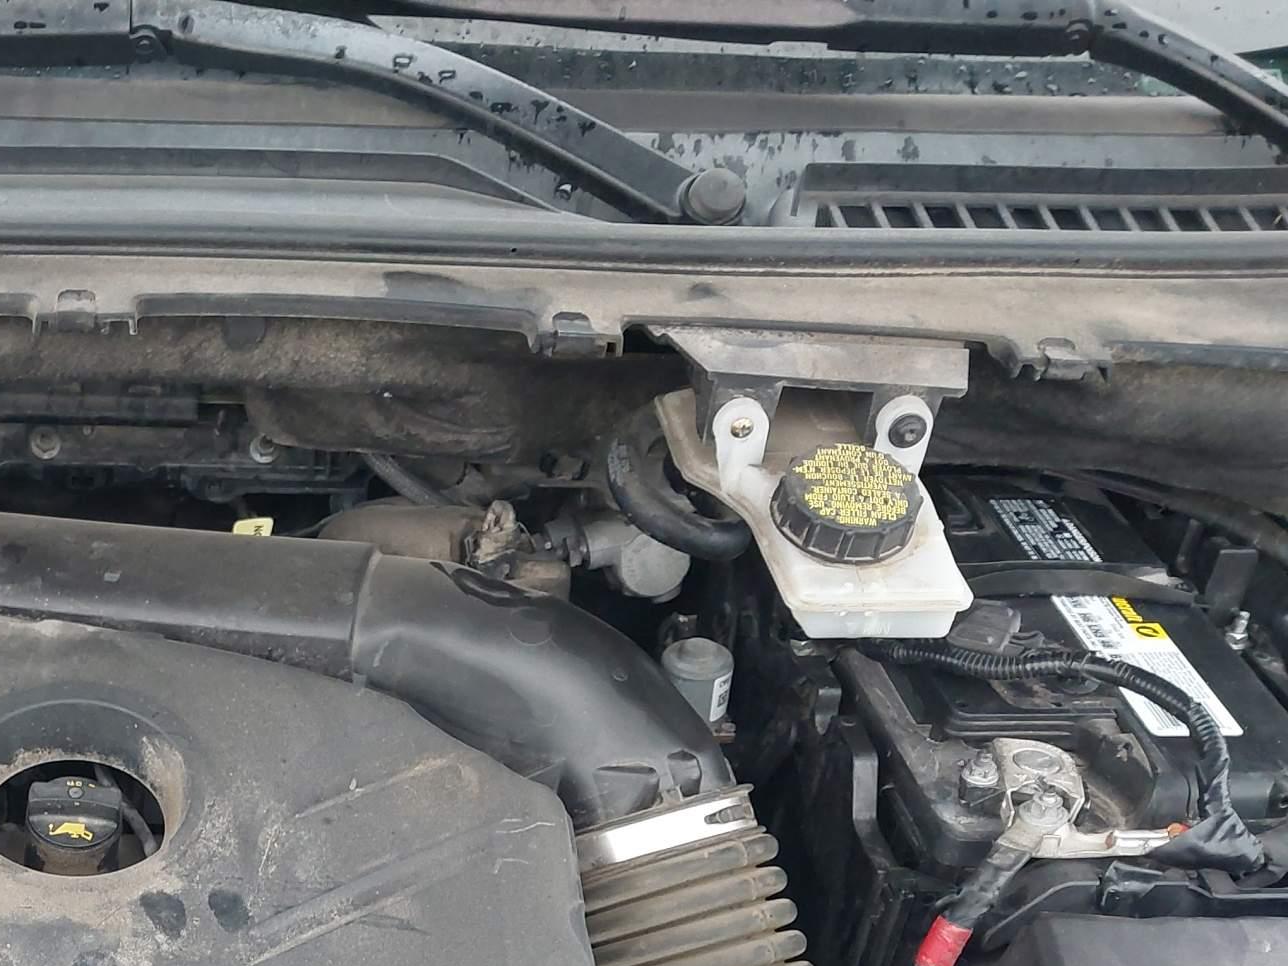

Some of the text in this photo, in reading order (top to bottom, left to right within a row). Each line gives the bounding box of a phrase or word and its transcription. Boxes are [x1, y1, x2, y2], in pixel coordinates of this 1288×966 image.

[805, 472, 843, 481] BOUCHON
[888, 472, 912, 482] AVANT
[804, 493, 828, 501] FROM
[832, 494, 855, 503] FLUID
[861, 489, 891, 499] SEALED
[869, 496, 884, 505] DOT
[888, 498, 909, 508] ONLY
[820, 507, 897, 520] CLEAN FILLER CAP
[876, 504, 906, 515] BEFORE
